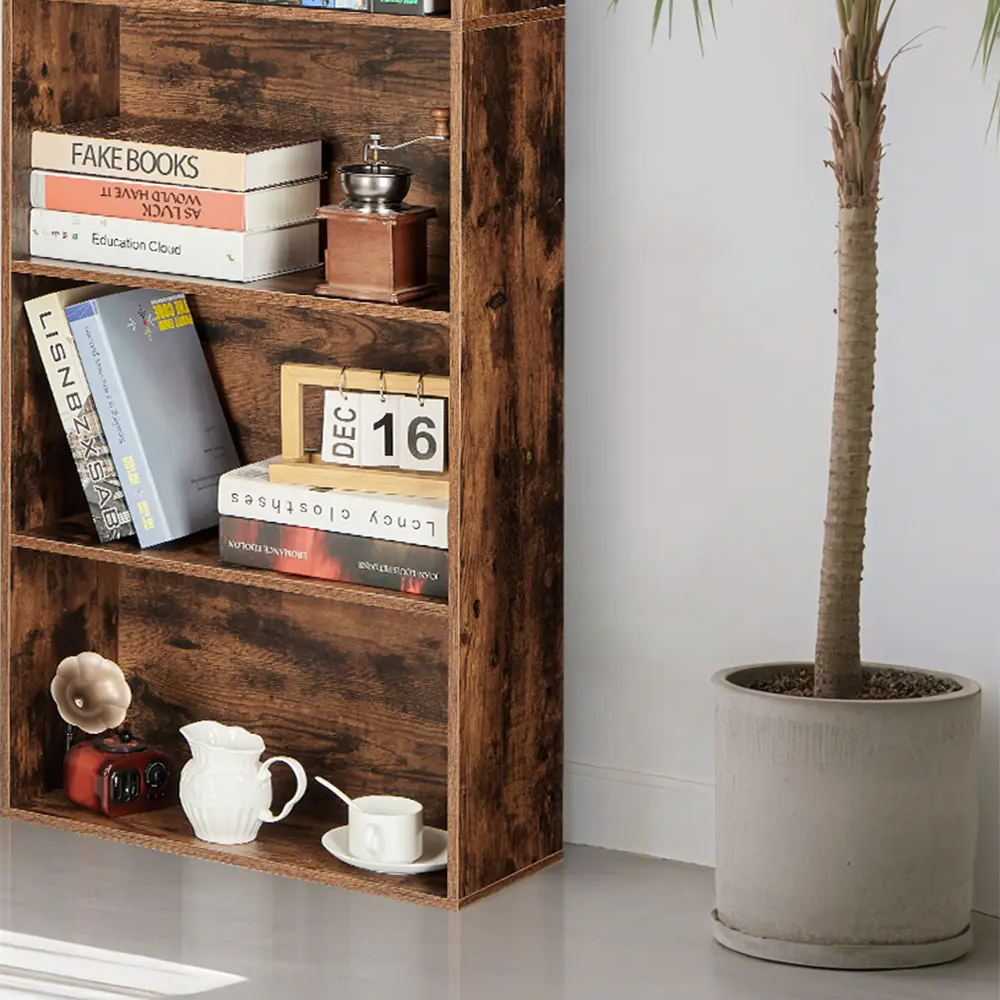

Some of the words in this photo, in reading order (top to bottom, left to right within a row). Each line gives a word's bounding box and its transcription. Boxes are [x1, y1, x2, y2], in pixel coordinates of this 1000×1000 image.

[71, 142, 123, 171] FAKE
[126, 147, 199, 180] BOOKS
[100, 186, 112, 197] IT
[114, 186, 149, 201] HAVE
[151, 190, 202, 207] WOULD
[141, 203, 181, 220] LUCK
[183, 207, 202, 220] AS
[91, 232, 147, 251] Education
[148, 240, 182, 256] Cloud
[37, 309, 122, 531] LISNBZXSAB
[331, 406, 357, 459] DEC
[230, 492, 351, 523] closthses
